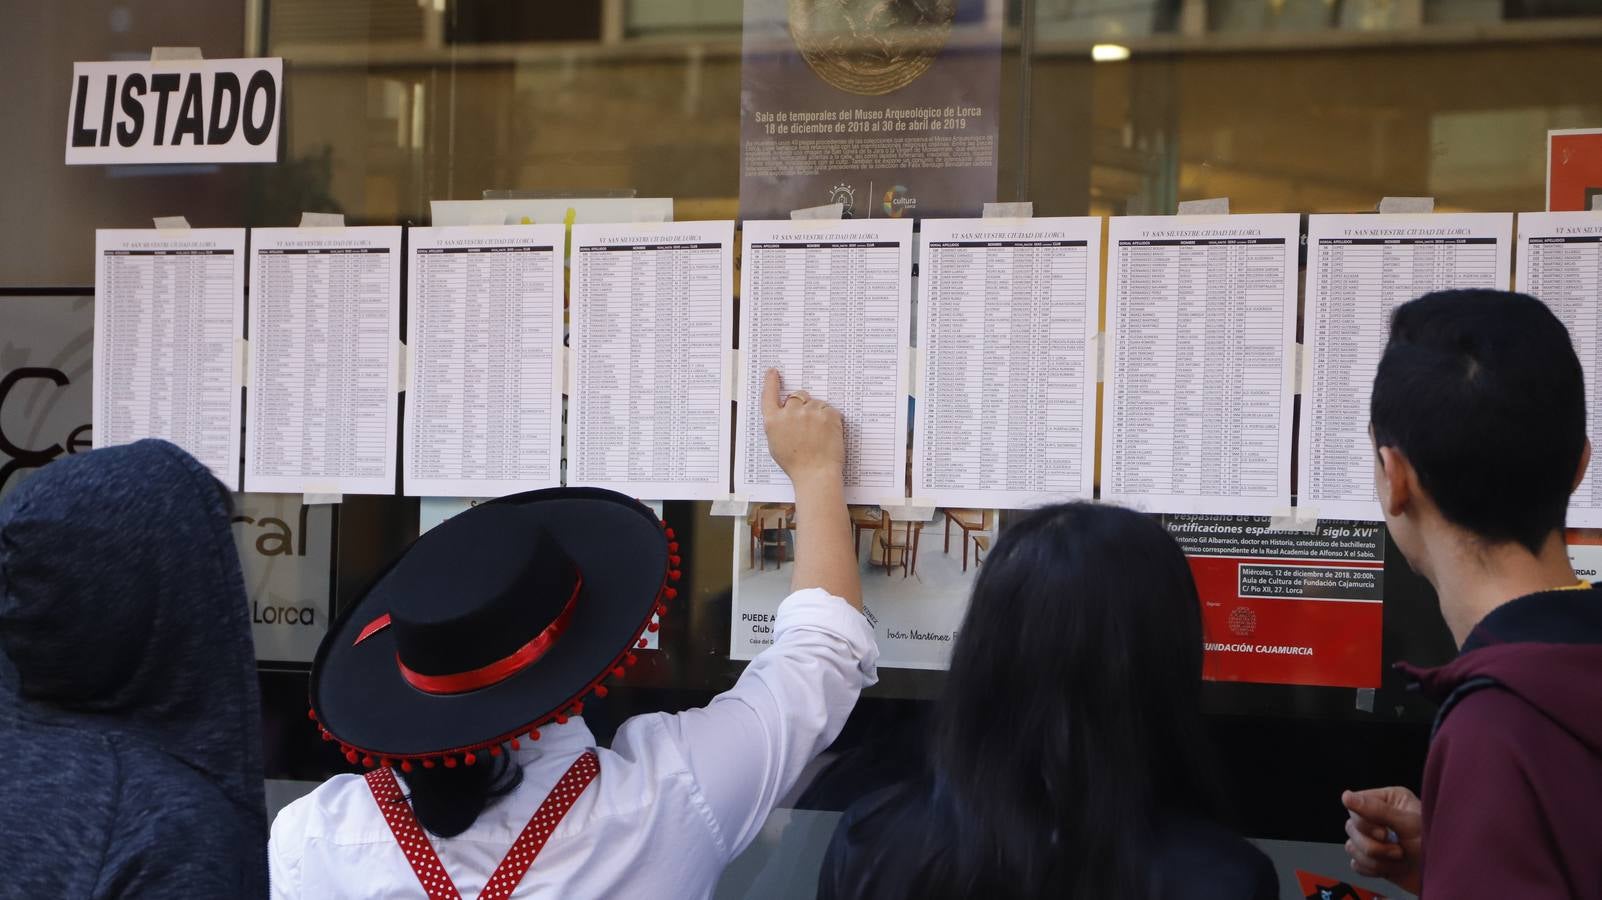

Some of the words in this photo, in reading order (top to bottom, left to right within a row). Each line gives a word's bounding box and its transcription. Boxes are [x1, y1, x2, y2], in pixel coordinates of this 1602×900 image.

[72, 70, 277, 148] LISTADO
[756, 112, 774, 122] Sala
[776, 111, 787, 122] de
[790, 110, 836, 122] temporales
[839, 110, 852, 120] del
[855, 108, 882, 119] Museo
[885, 107, 941, 120] Arqueológico
[944, 106, 954, 117] de
[957, 106, 982, 117] Lorca
[764, 124, 776, 134] 18
[778, 123, 788, 134] de
[790, 122, 832, 134] diciembre
[835, 122, 846, 132] de
[848, 121, 870, 132] 2018
[872, 120, 880, 130] al
[882, 120, 893, 130] 30
[895, 120, 906, 130] de
[908, 119, 928, 130] abril
[931, 119, 942, 130] de
[944, 118, 966, 130] 2019
[1168, 522, 1243, 533] fortificaciones
[1322, 527, 1350, 538] siglo
[1242, 569, 1273, 577] Miércoles,
[1338, 580, 1375, 588] Cajamurcia
[253, 600, 314, 625] Lorca
[742, 614, 768, 622] PUEDE
[752, 625, 770, 633] Club
[910, 629, 950, 641] Martínez
[1255, 645, 1313, 656] CAJAMURCIA
